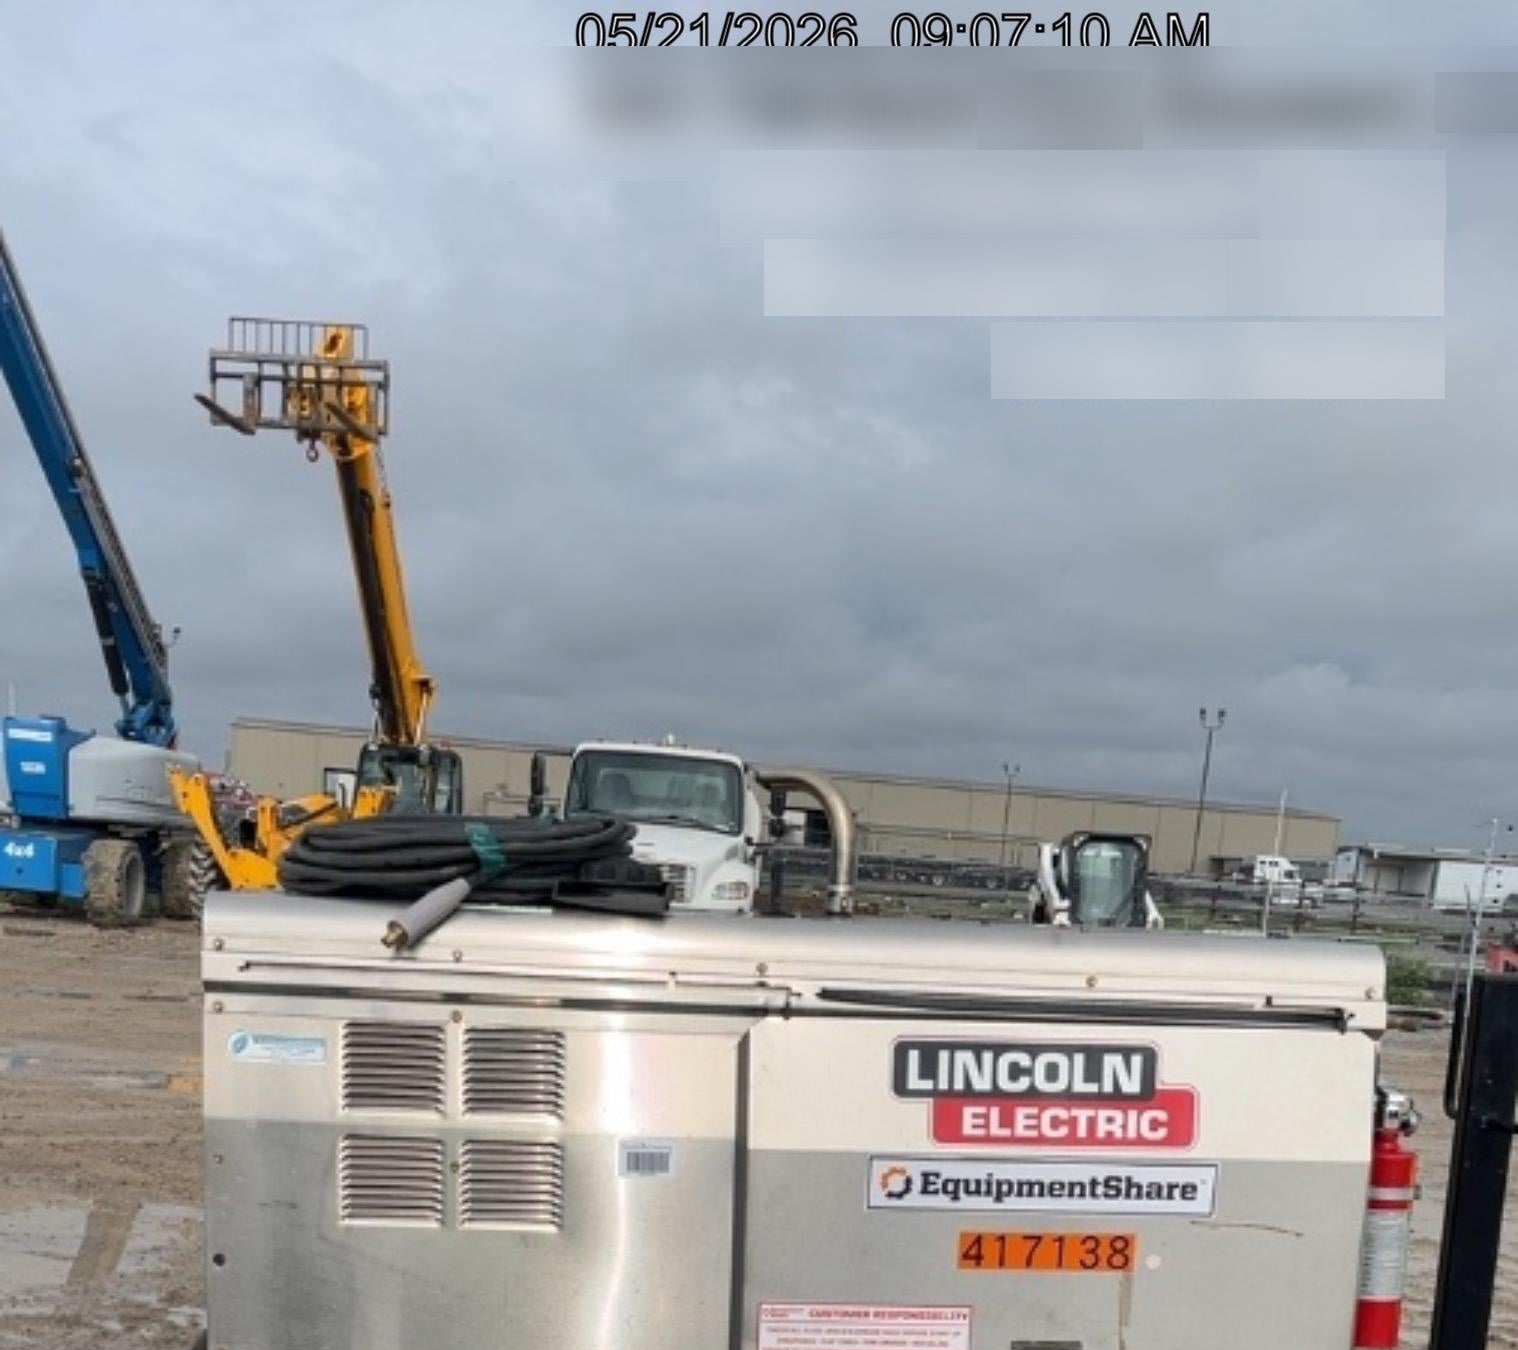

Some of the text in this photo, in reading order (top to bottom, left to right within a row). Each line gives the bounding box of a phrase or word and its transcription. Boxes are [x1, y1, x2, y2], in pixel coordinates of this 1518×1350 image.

[906, 1049, 1144, 1094] LINCOLN
[962, 1106, 1169, 1141] ELECTRIC
[920, 1171, 1198, 1203] EquipmentShare
[962, 1234, 1130, 1269] 417138
